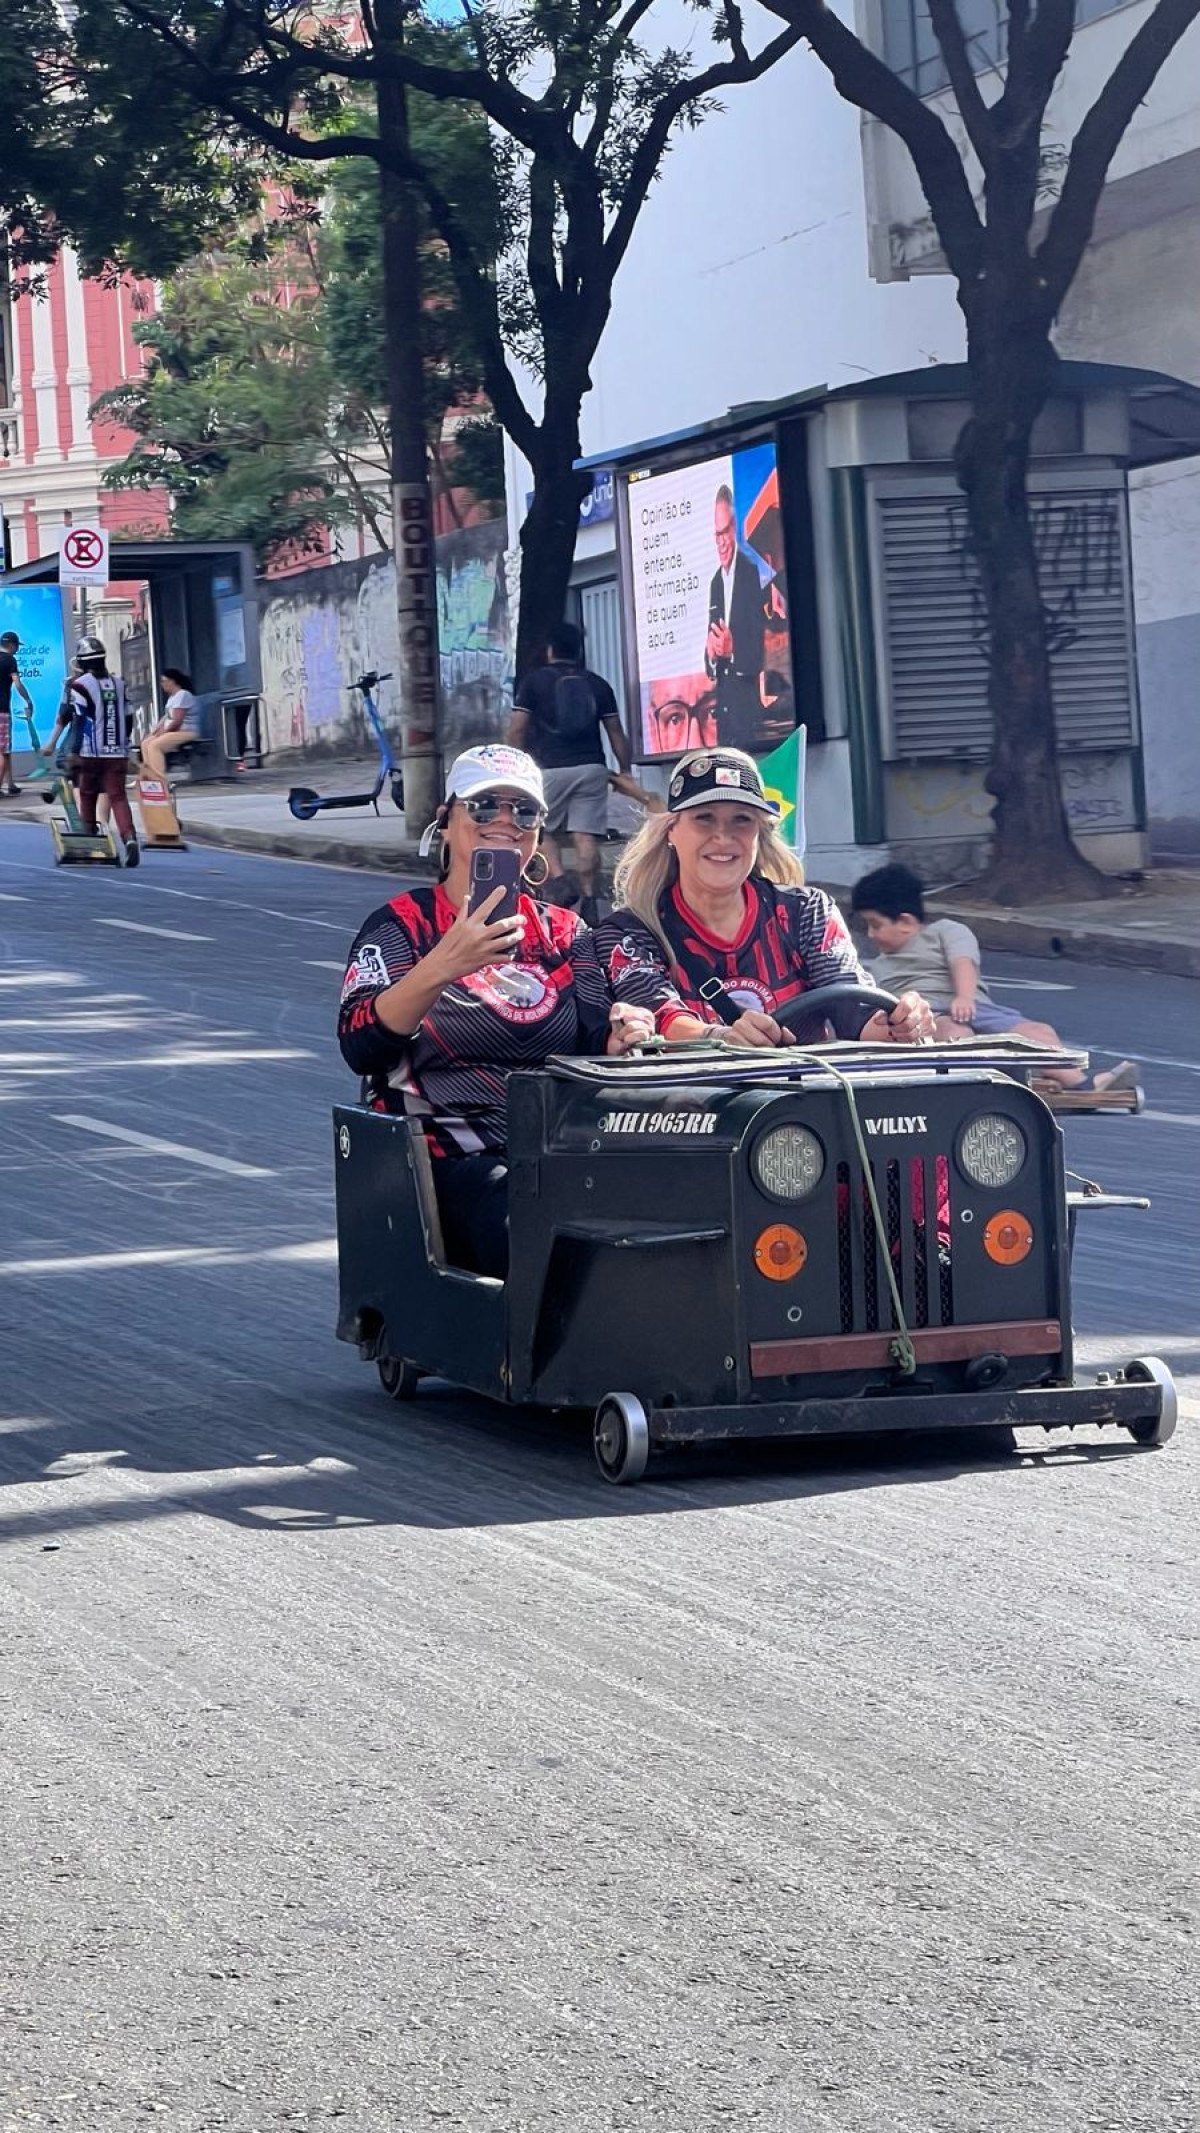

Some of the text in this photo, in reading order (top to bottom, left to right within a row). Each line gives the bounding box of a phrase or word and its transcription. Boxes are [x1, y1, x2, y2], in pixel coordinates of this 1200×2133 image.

[642, 499, 691, 527] Opinião de
[643, 532, 668, 553] quem
[644, 551, 686, 575] entende.
[402, 498, 435, 703] BOUTIQUE
[647, 603, 687, 625] de quem
[603, 1112, 928, 1135] MH1965RR WILLYS
